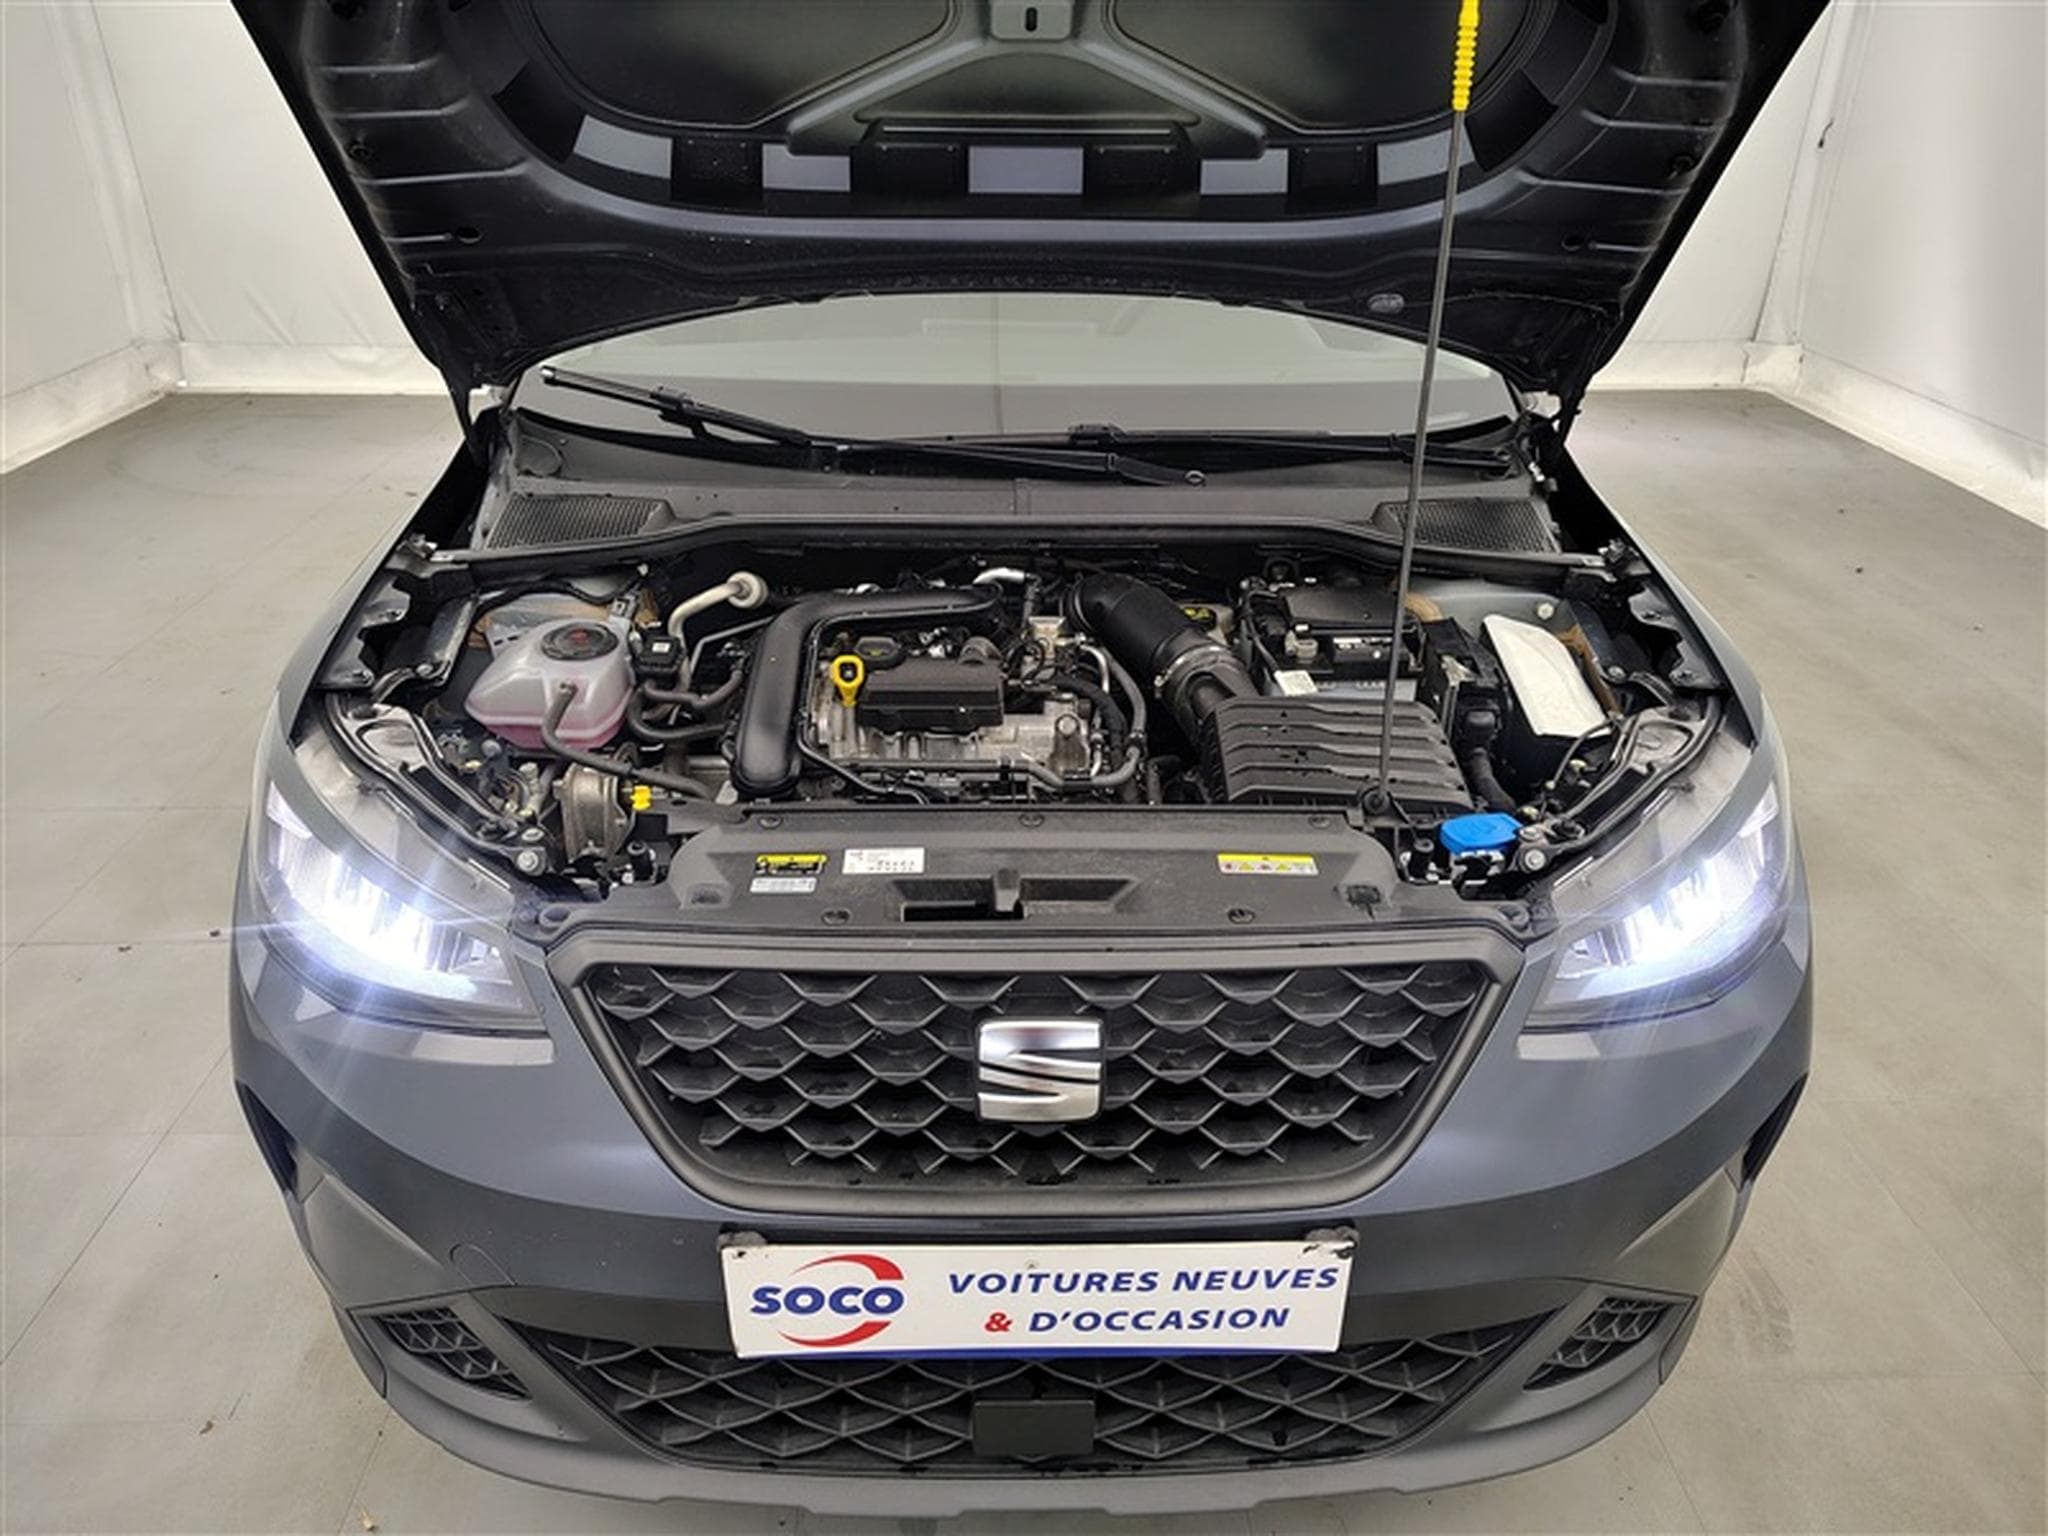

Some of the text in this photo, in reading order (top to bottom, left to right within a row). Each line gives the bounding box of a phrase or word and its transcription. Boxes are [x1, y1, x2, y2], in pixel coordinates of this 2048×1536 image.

[949, 1267, 1339, 1295] VOITURES NEUVES
[750, 1284, 905, 1316] SOCO
[983, 1311, 1012, 1334] &
